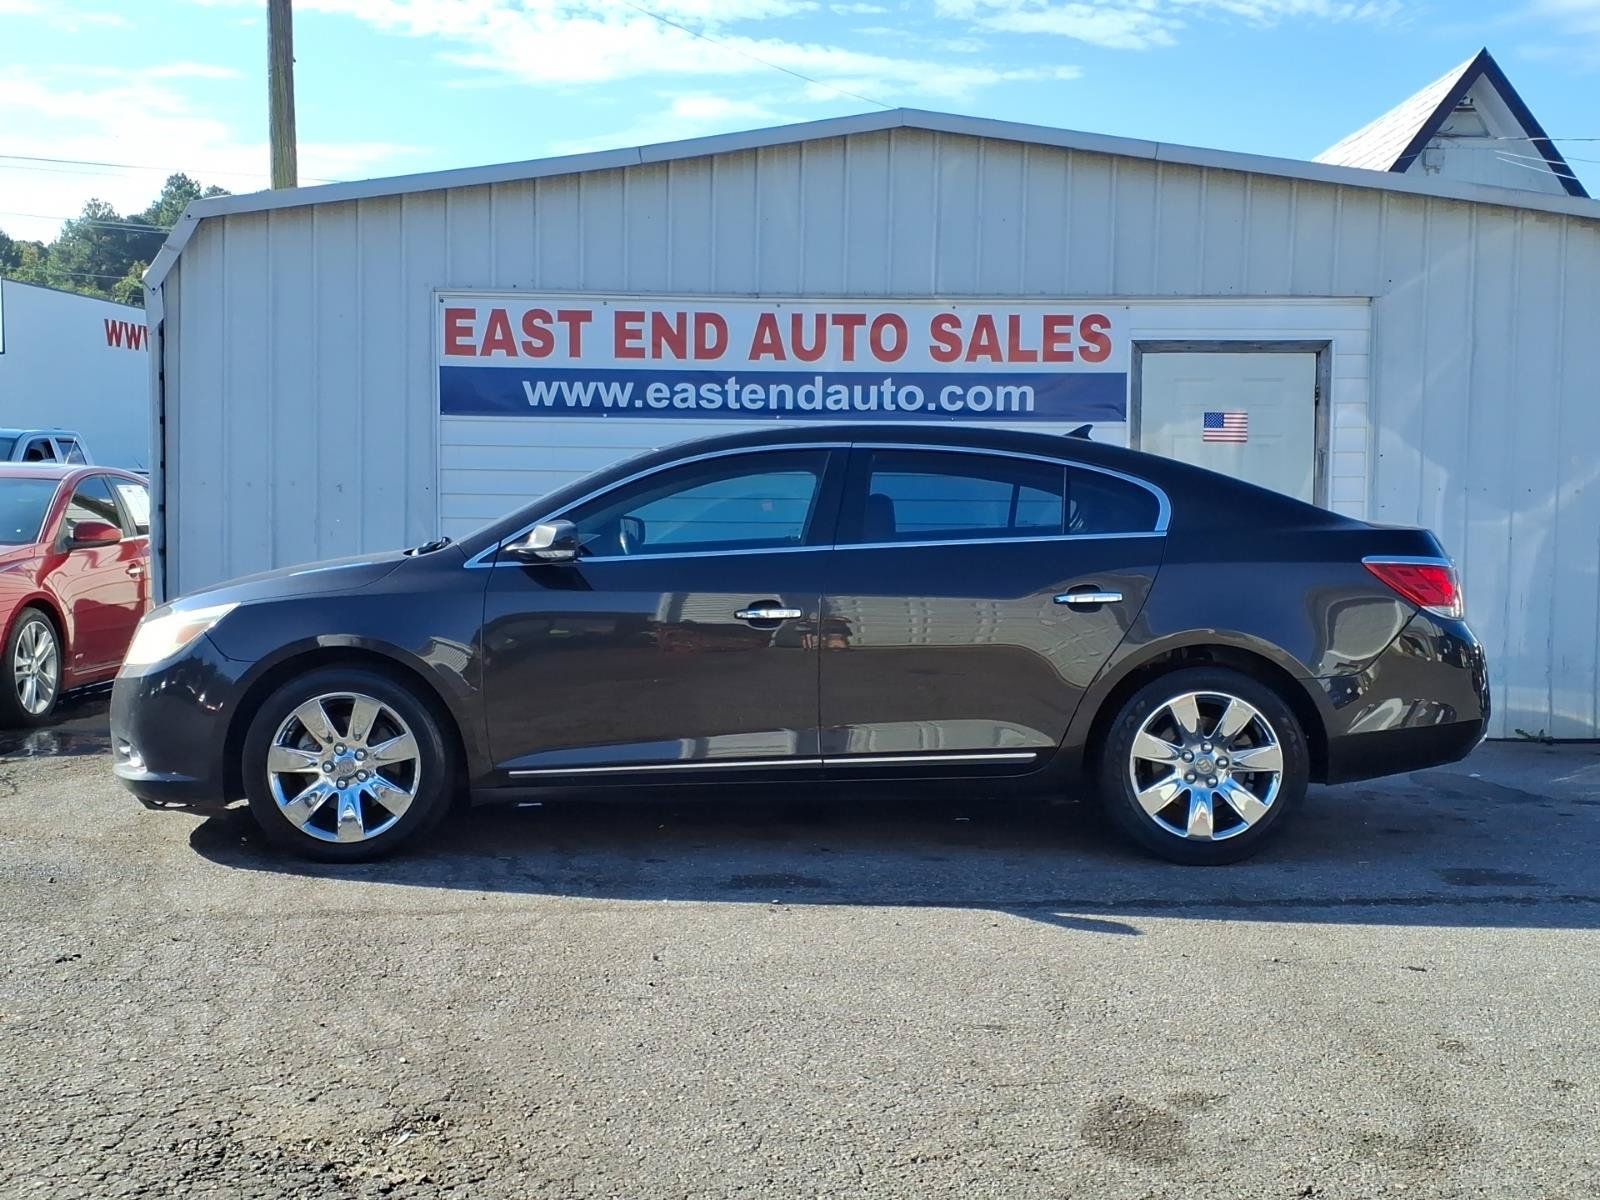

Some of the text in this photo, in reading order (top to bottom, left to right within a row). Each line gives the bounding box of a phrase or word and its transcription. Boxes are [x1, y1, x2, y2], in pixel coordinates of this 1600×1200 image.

[104, 319, 148, 352] WW
[445, 308, 1112, 362] EAST END AUTO SALES
[522, 376, 1035, 411] www.eastendauto.com
